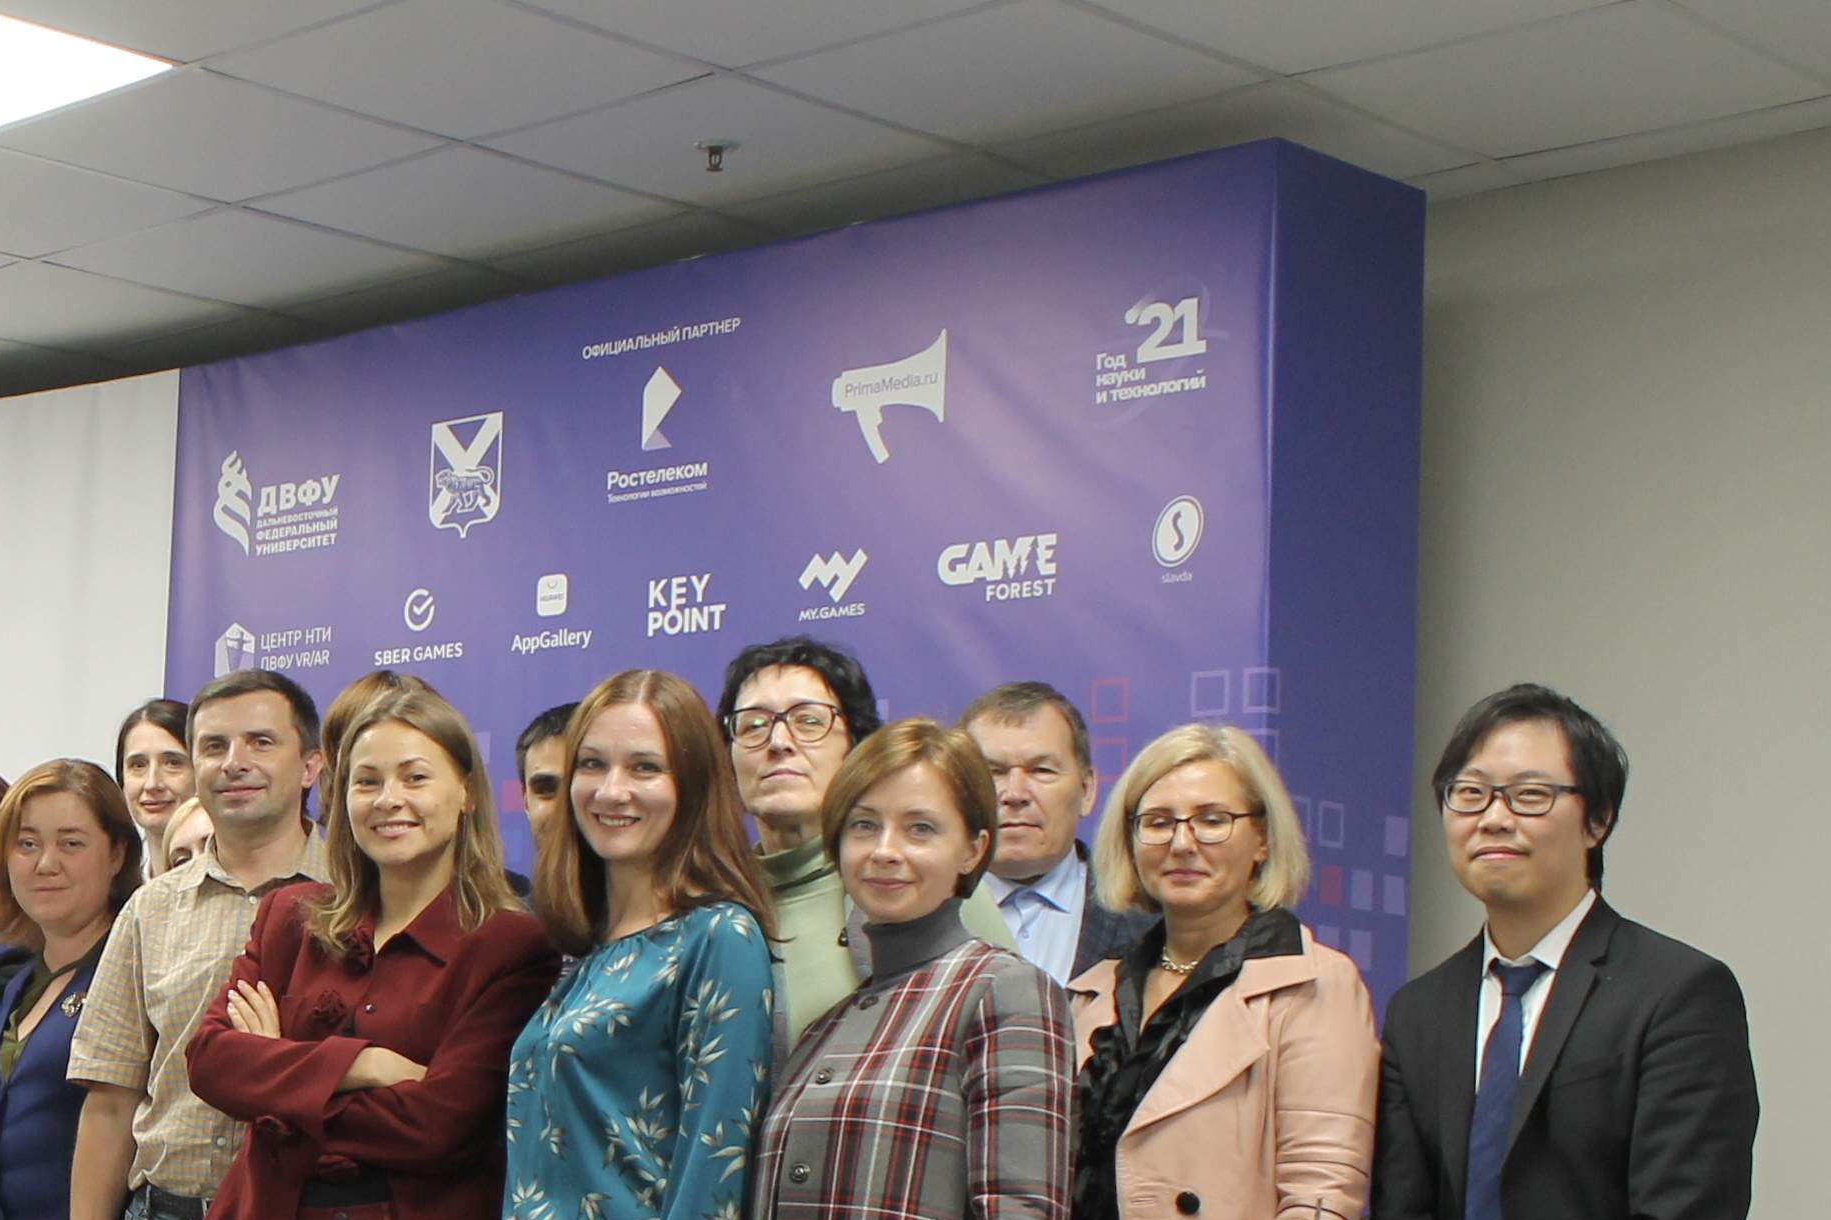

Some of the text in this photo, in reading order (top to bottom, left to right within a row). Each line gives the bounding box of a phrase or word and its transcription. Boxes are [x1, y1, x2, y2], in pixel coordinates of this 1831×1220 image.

[582, 317, 741, 360] ОФИЦИАЛЬНЫЙ ПАРТНЕР
[1096, 353, 1127, 370] Год
[844, 373, 938, 398] PrimaMedia.ru
[1096, 367, 1146, 387] науки
[1109, 369, 1206, 402] технологий
[607, 462, 708, 490] Ростелеком
[257, 474, 340, 517] ДВФУ
[256, 505, 338, 528] ДАЛЬНЕВОСТОЧНЫЙ
[256, 516, 338, 541] ФЕДЕРАЛЬНЫЙ
[256, 533, 337, 556] УНИВЕРСИТЕТ
[937, 533, 1057, 586] GAME
[648, 573, 711, 610] KEY
[985, 578, 1056, 602] FOREST
[647, 603, 726, 637] POINT
[798, 603, 866, 621] MY.GAMES
[260, 626, 332, 652] ЦЕНТР НТИ
[511, 628, 593, 655] AppGallery
[295, 649, 330, 668] VR/AR
[374, 642, 463, 666] SBER GAMES
